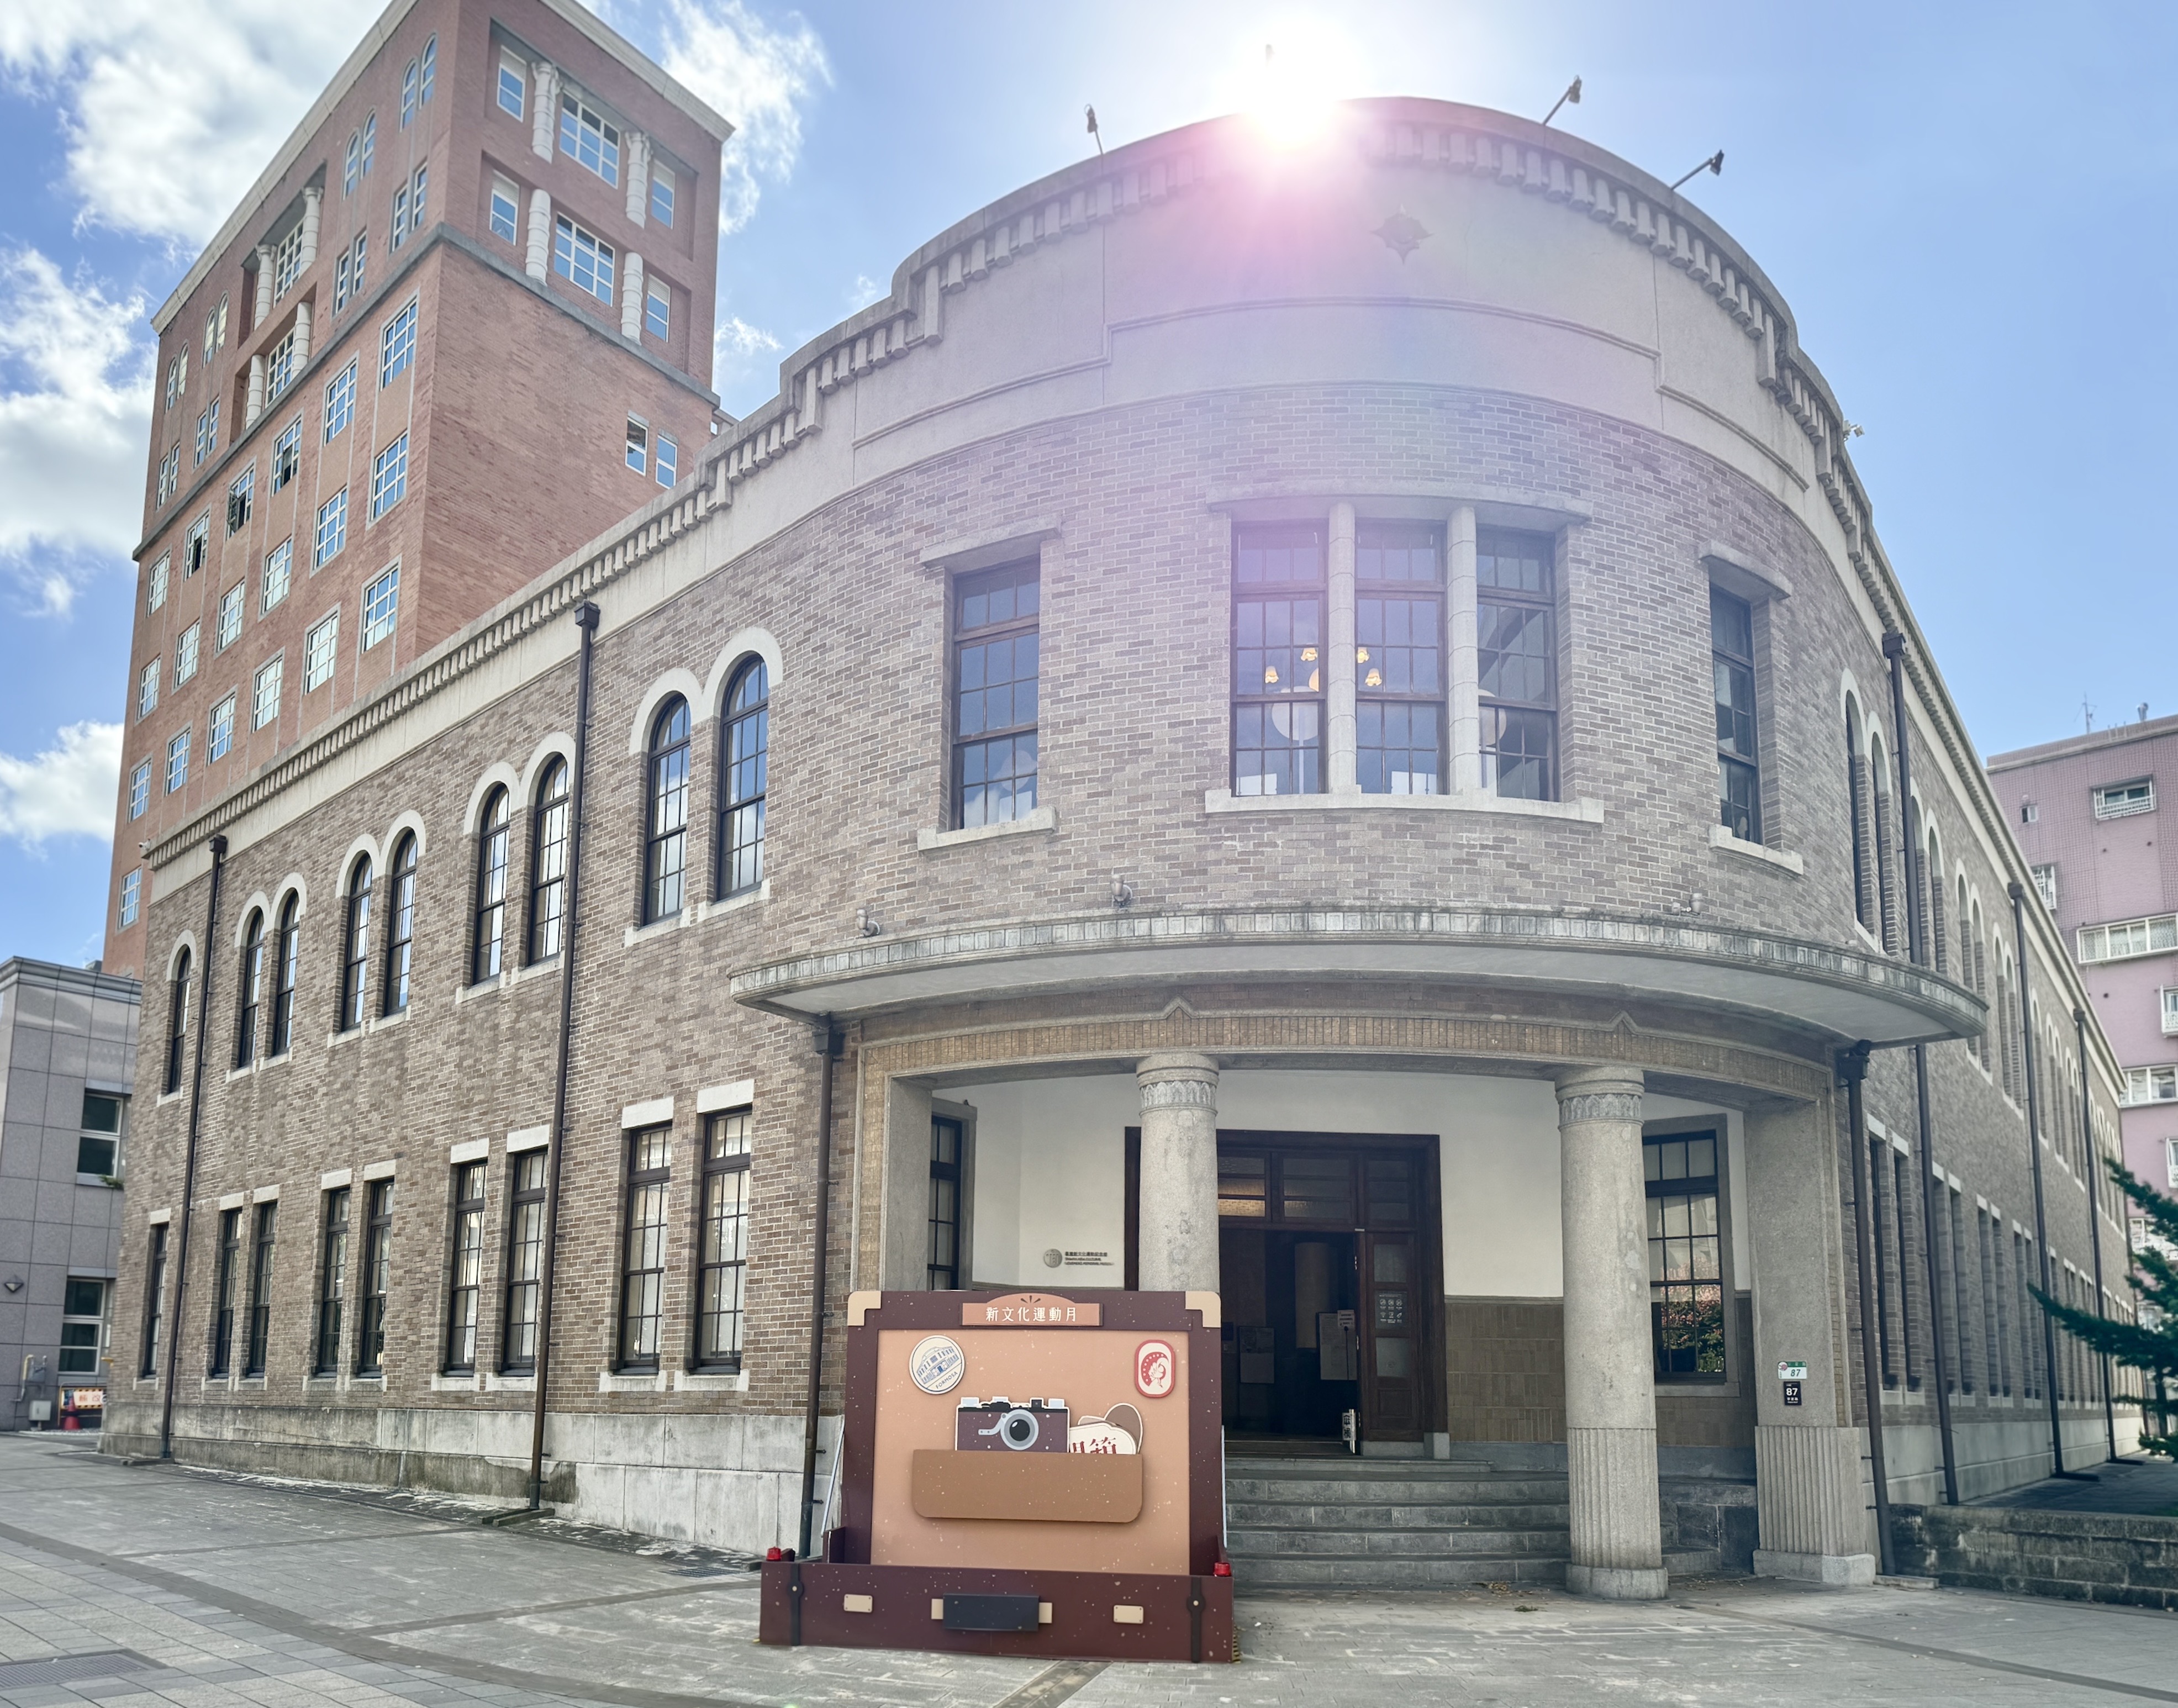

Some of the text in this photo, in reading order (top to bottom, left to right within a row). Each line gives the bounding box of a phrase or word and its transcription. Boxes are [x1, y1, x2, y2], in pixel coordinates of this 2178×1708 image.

[986, 1306, 1076, 1322] 新文化運動月
[936, 1371, 958, 1389] FORMOSA
[1786, 1388, 1798, 1396] 87
